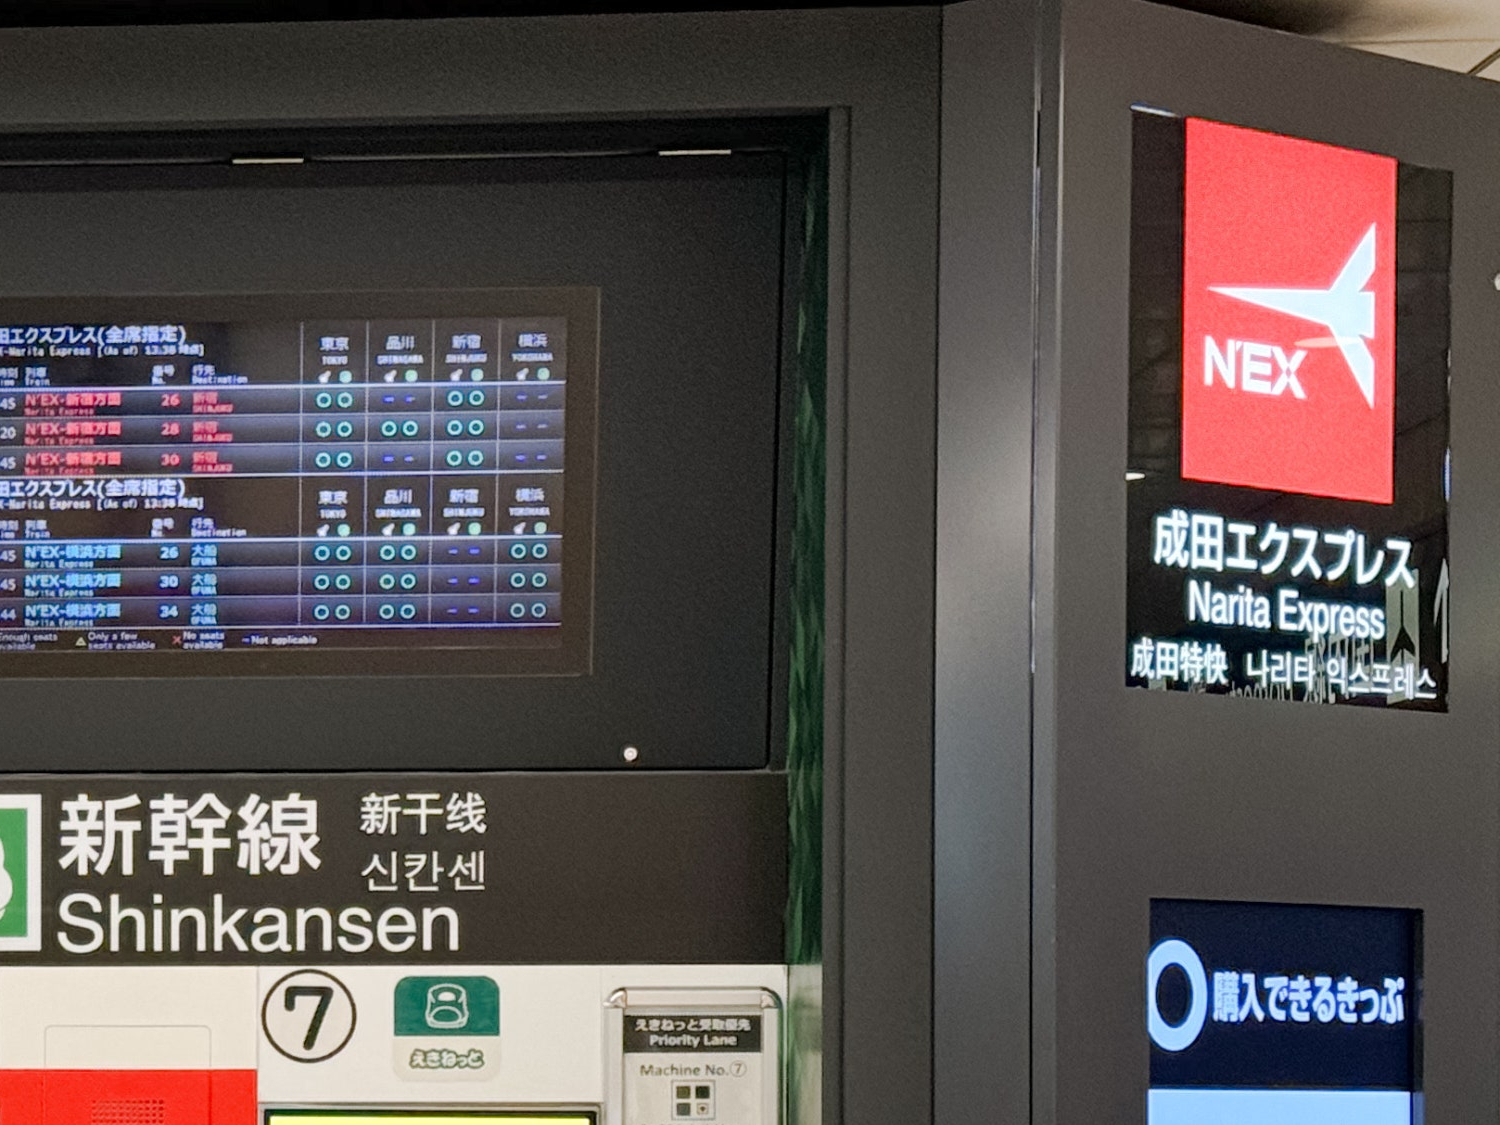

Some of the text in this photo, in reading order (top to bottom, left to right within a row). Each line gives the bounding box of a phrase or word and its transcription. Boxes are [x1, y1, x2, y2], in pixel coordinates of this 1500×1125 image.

[161, 394, 180, 407] 26
[161, 423, 180, 436] 28
[161, 453, 180, 466] 30
[160, 547, 178, 559] 26
[1154, 509, 1416, 590] 成田エクスプレス
[160, 575, 178, 587] 30
[160, 605, 178, 617] 34
[1188, 579, 1386, 643] Narita Express
[251, 635, 268, 644] Not
[1130, 637, 1229, 684] 成田特快
[1246, 650, 1317, 689] 나리타
[1326, 657, 1438, 700] 익스프레스
[359, 792, 488, 834] 新干线
[58, 793, 322, 876] 新幹線
[360, 850, 486, 893] 신칸센
[56, 893, 462, 953] Shinkansen
[1213, 971, 1405, 1024] 購入できるきっぷ
[649, 1033, 738, 1047] Priority Lane
[409, 1049, 485, 1069] えきねっと
[640, 1064, 701, 1077] Machine
